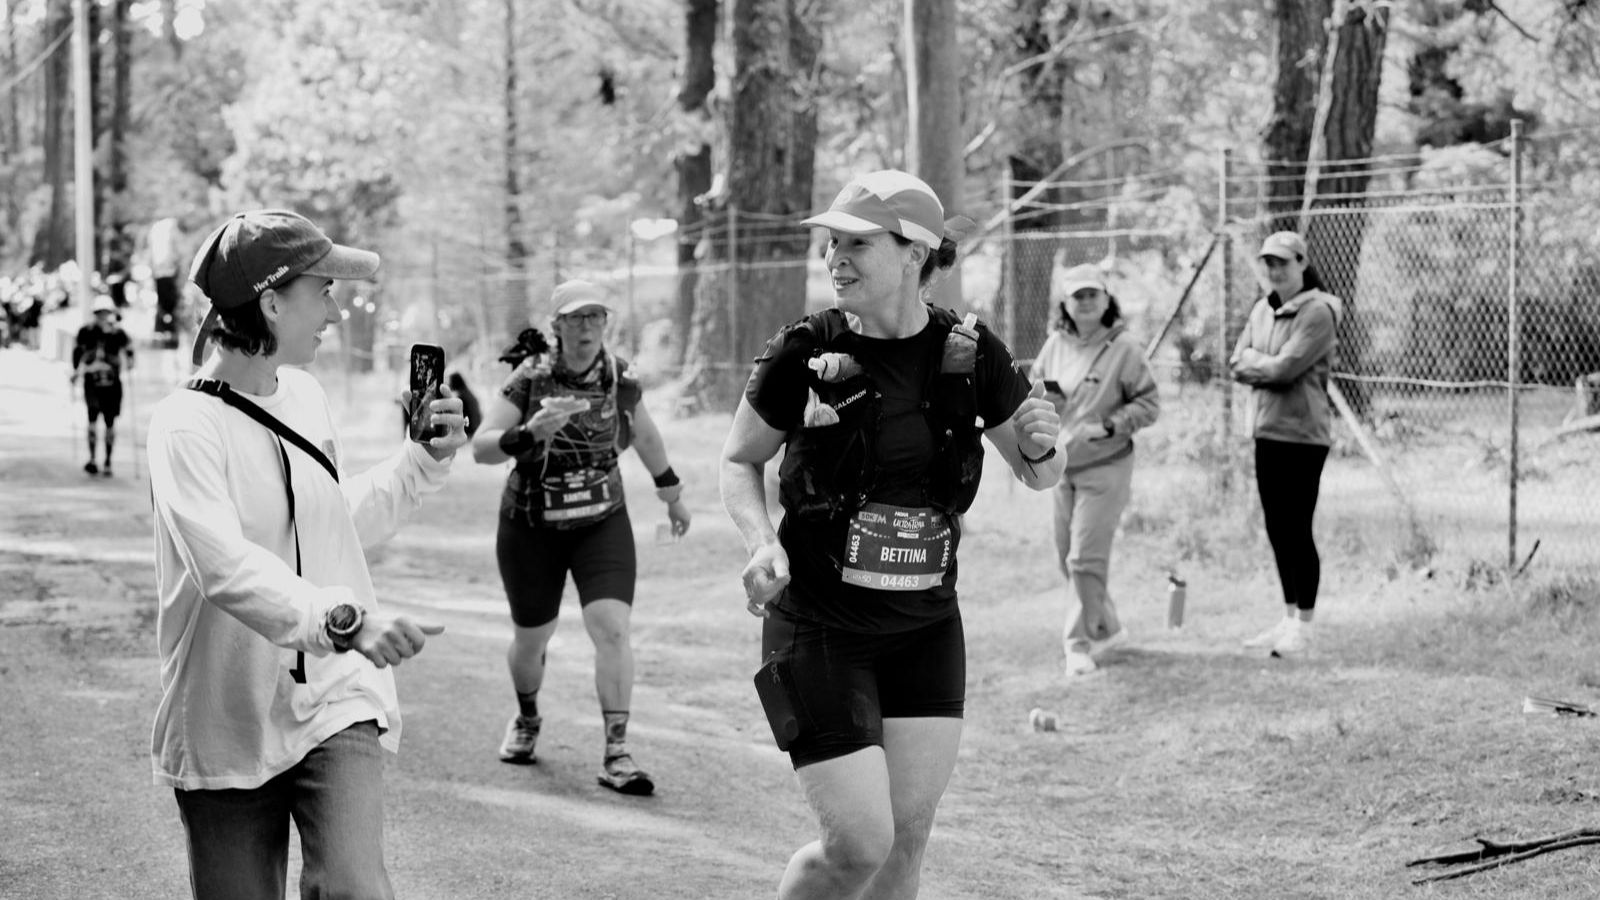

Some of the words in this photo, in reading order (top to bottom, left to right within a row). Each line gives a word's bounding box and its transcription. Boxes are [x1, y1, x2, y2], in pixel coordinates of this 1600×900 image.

[834, 389, 866, 410] SALOMON
[849, 534, 860, 563] 04463
[880, 546, 927, 563] BETTINA
[941, 540, 950, 567] 04463
[880, 574, 920, 588] 04463
